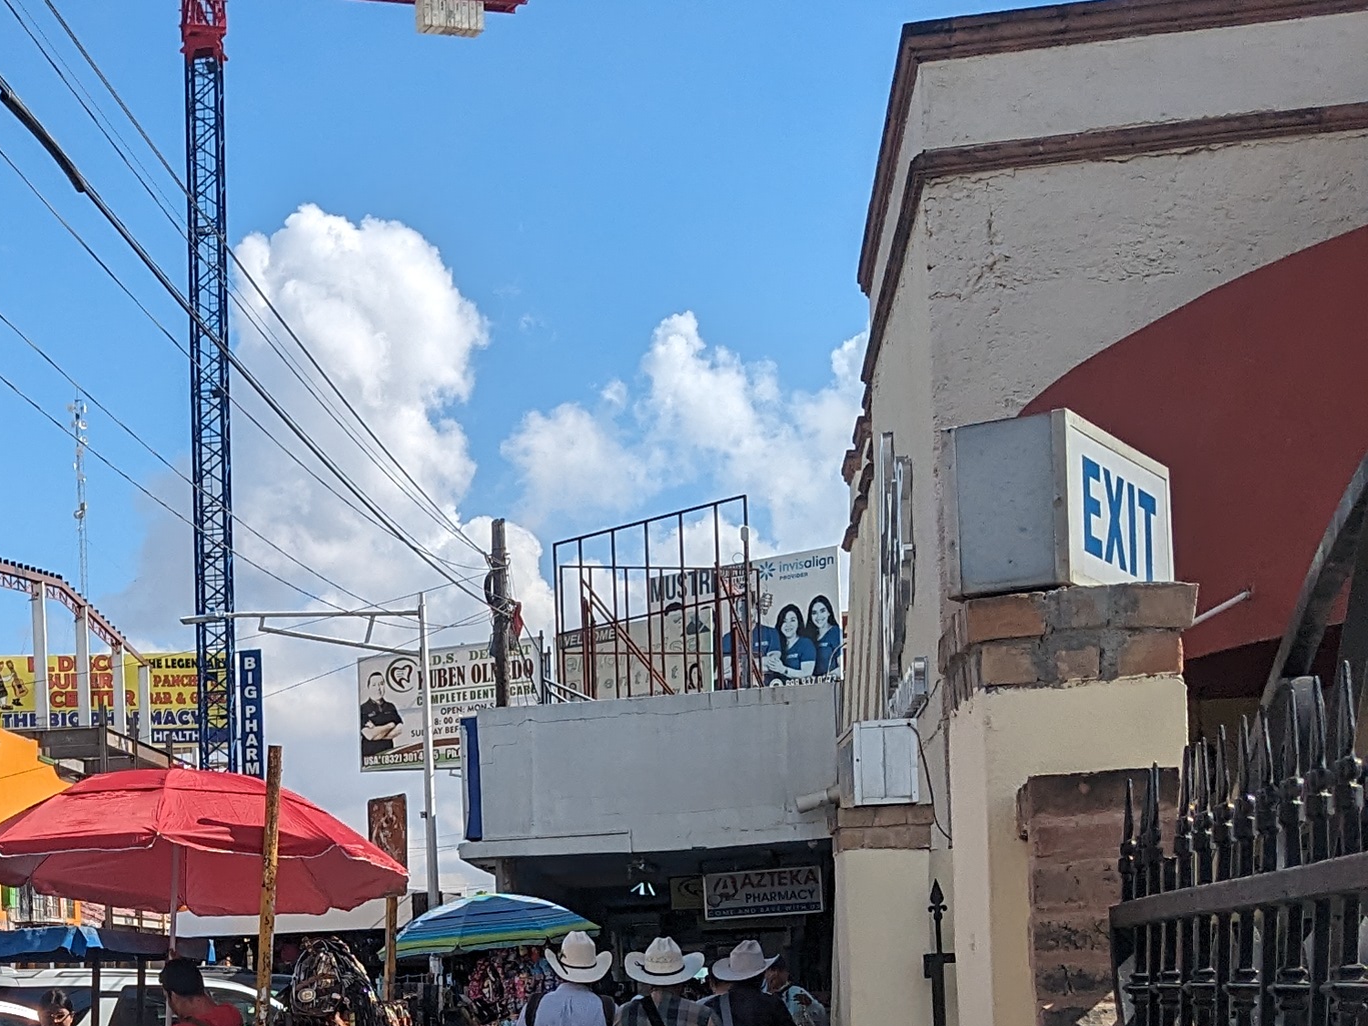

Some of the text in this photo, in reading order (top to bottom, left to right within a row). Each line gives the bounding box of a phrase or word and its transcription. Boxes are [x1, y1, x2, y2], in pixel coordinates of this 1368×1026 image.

[1081, 454, 1157, 582] EXIT
[779, 556, 835, 573] invisalign
[779, 571, 809, 581] PROVIDER
[562, 627, 616, 648] WELOME
[243, 656, 258, 699] BIG
[175, 691, 187, 705] &
[416, 690, 467, 706] CMPLETE
[469, 687, 496, 702] DENT
[440, 705, 465, 716] OPEN:
[410, 729, 443, 738] SUAY
[740, 868, 820, 890] AZTEKA
[744, 889, 816, 904] PHARMACY
